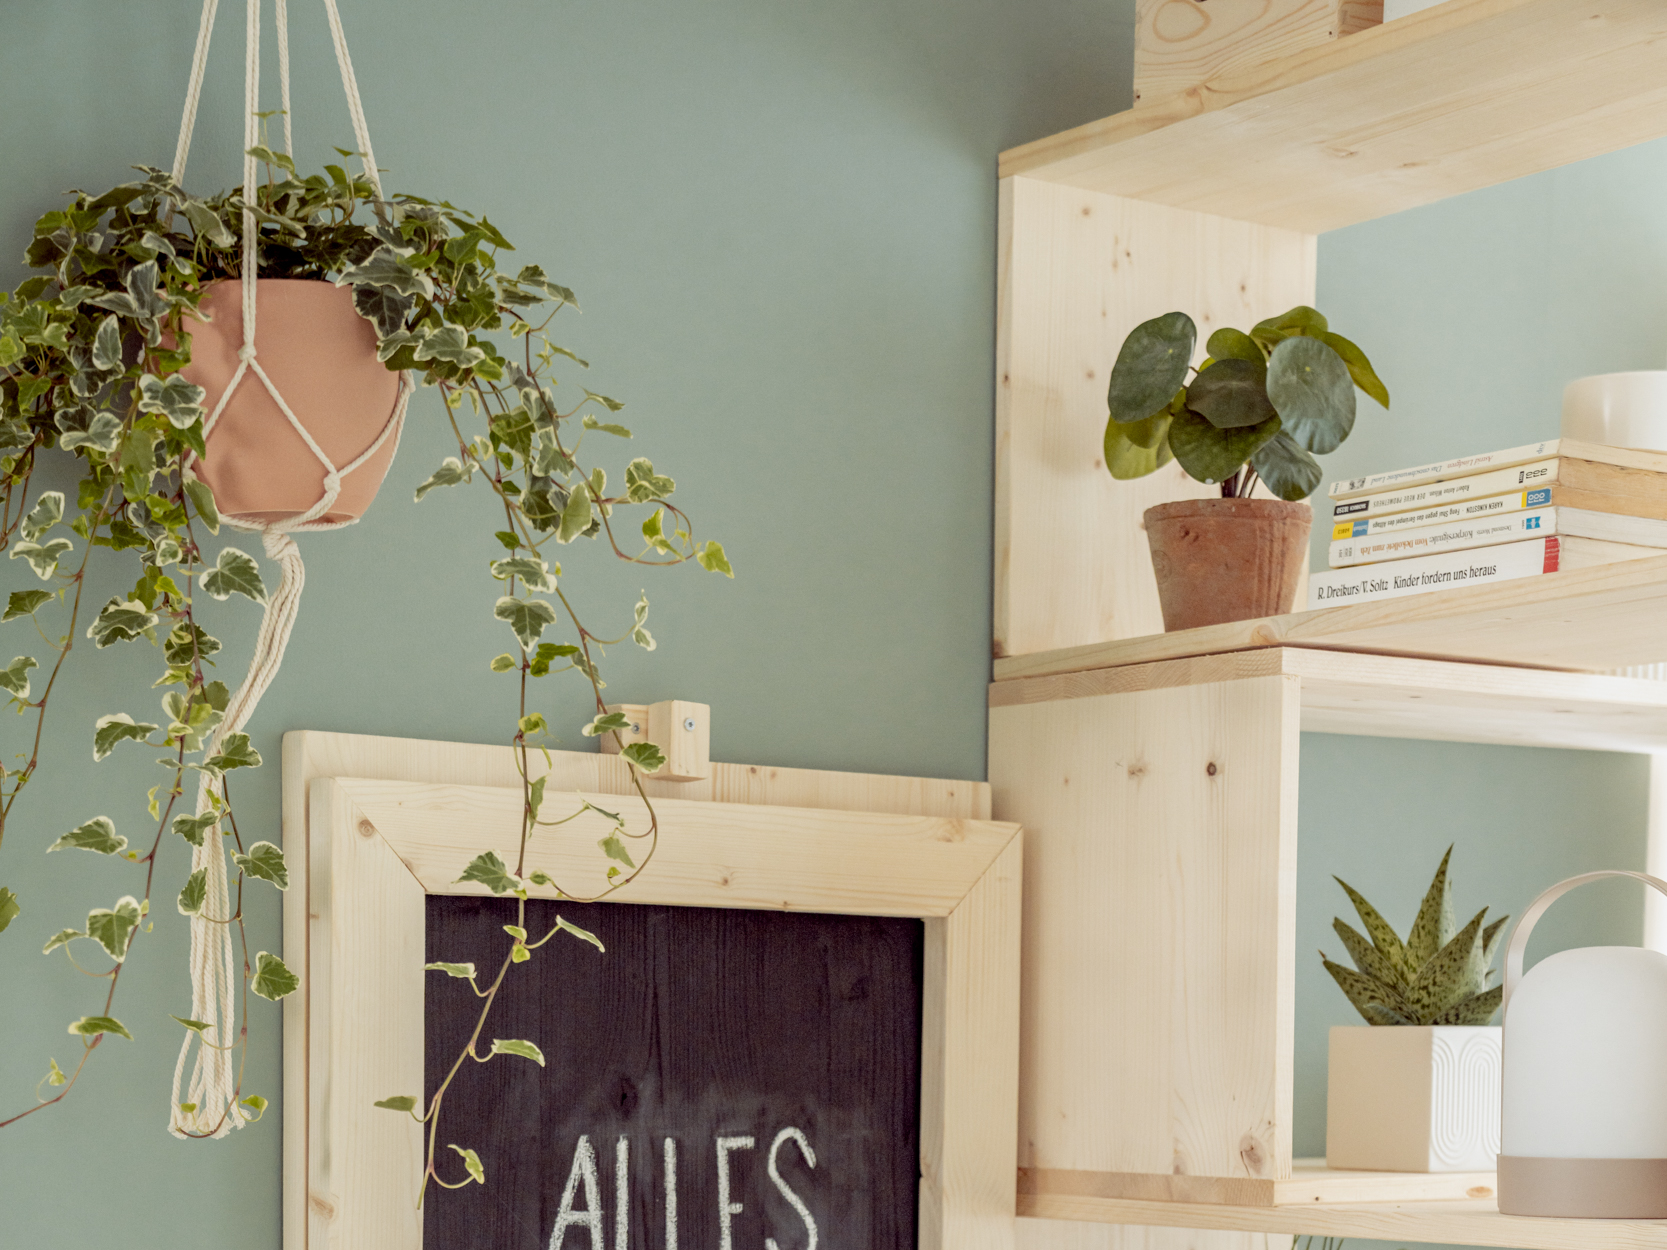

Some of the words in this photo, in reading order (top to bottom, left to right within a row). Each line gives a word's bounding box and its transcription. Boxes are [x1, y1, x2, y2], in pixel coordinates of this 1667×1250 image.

[1447, 459, 1474, 468] Lindgren
[1473, 455, 1493, 464] Astrid
[1370, 476, 1385, 485] Land
[1417, 492, 1426, 500] DER
[1373, 497, 1402, 508] PROMETHEUS
[1488, 501, 1503, 509] KAREN
[1466, 504, 1487, 514] KINGSTON
[1425, 511, 1438, 519] gegen
[1396, 516, 1415, 525] Gerümpel
[1415, 538, 1428, 546] Vom
[1361, 547, 1371, 556] Zeh
[1372, 544, 1385, 552] zum
[1318, 587, 1325, 600] R.
[1326, 580, 1368, 599] Dreikurs/V.
[1370, 579, 1389, 592] Soltz
[1393, 574, 1419, 589] Kinder
[1421, 571, 1451, 586] fordern
[1453, 569, 1467, 581] uns
[1469, 564, 1497, 578] heraus
